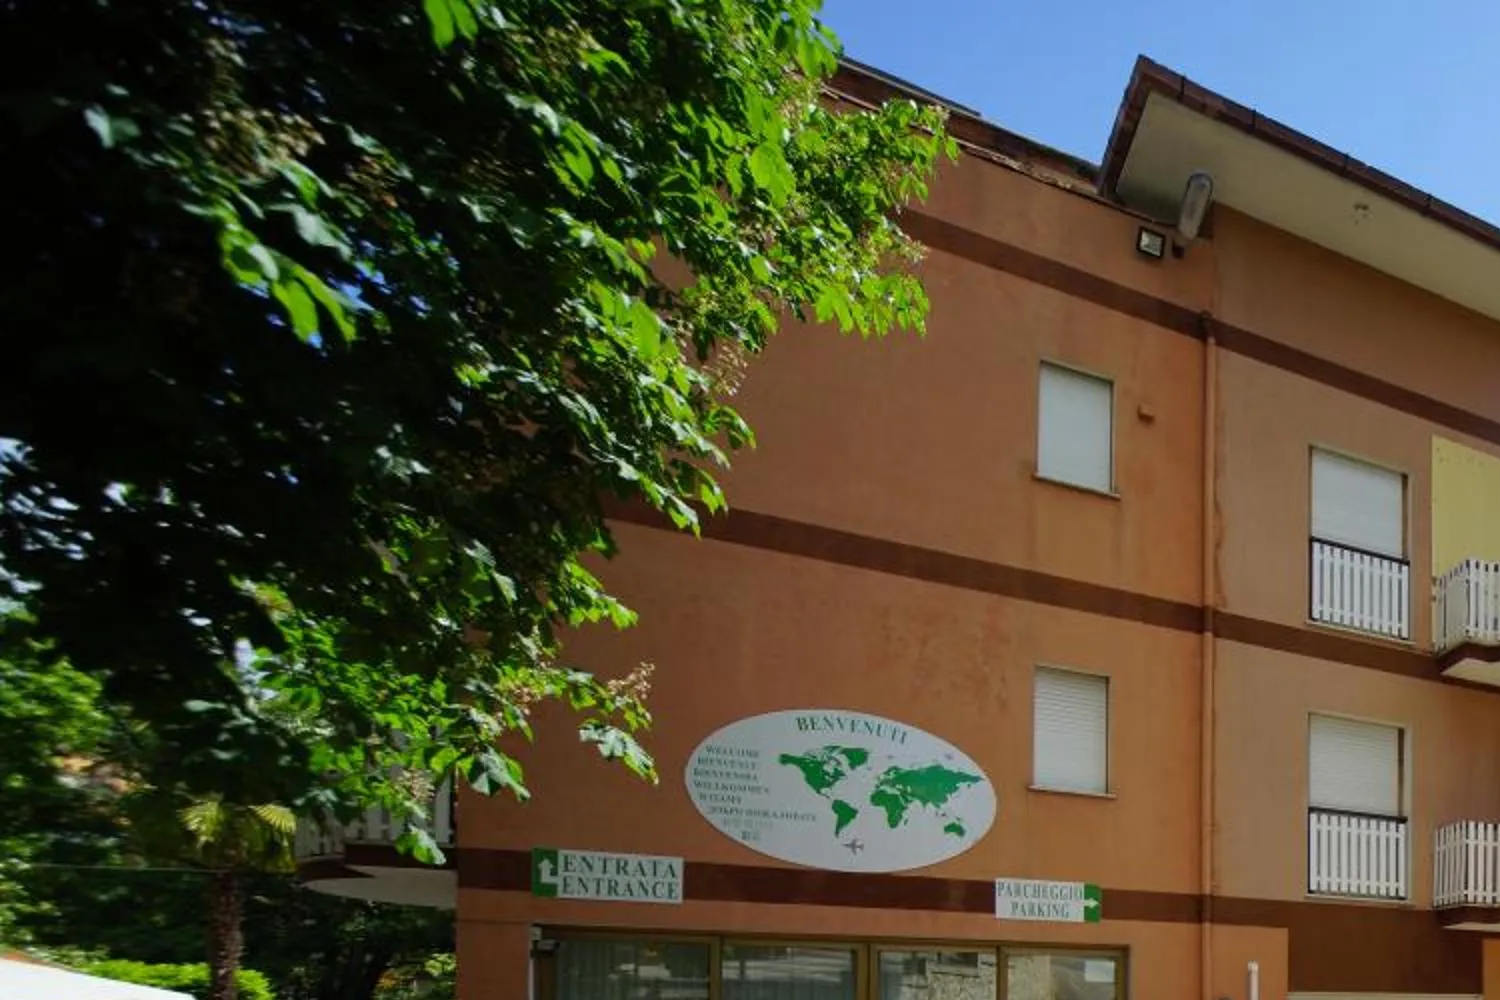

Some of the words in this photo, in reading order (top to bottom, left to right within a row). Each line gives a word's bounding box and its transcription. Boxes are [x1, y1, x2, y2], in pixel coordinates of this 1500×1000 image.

[796, 716, 907, 745] BENVENUTI
[562, 853, 677, 878] ENTRATA
[561, 876, 678, 900] ENTRANCE
[997, 881, 1084, 901] PARCHEGGIO
[1011, 901, 1069, 918] PARKING
